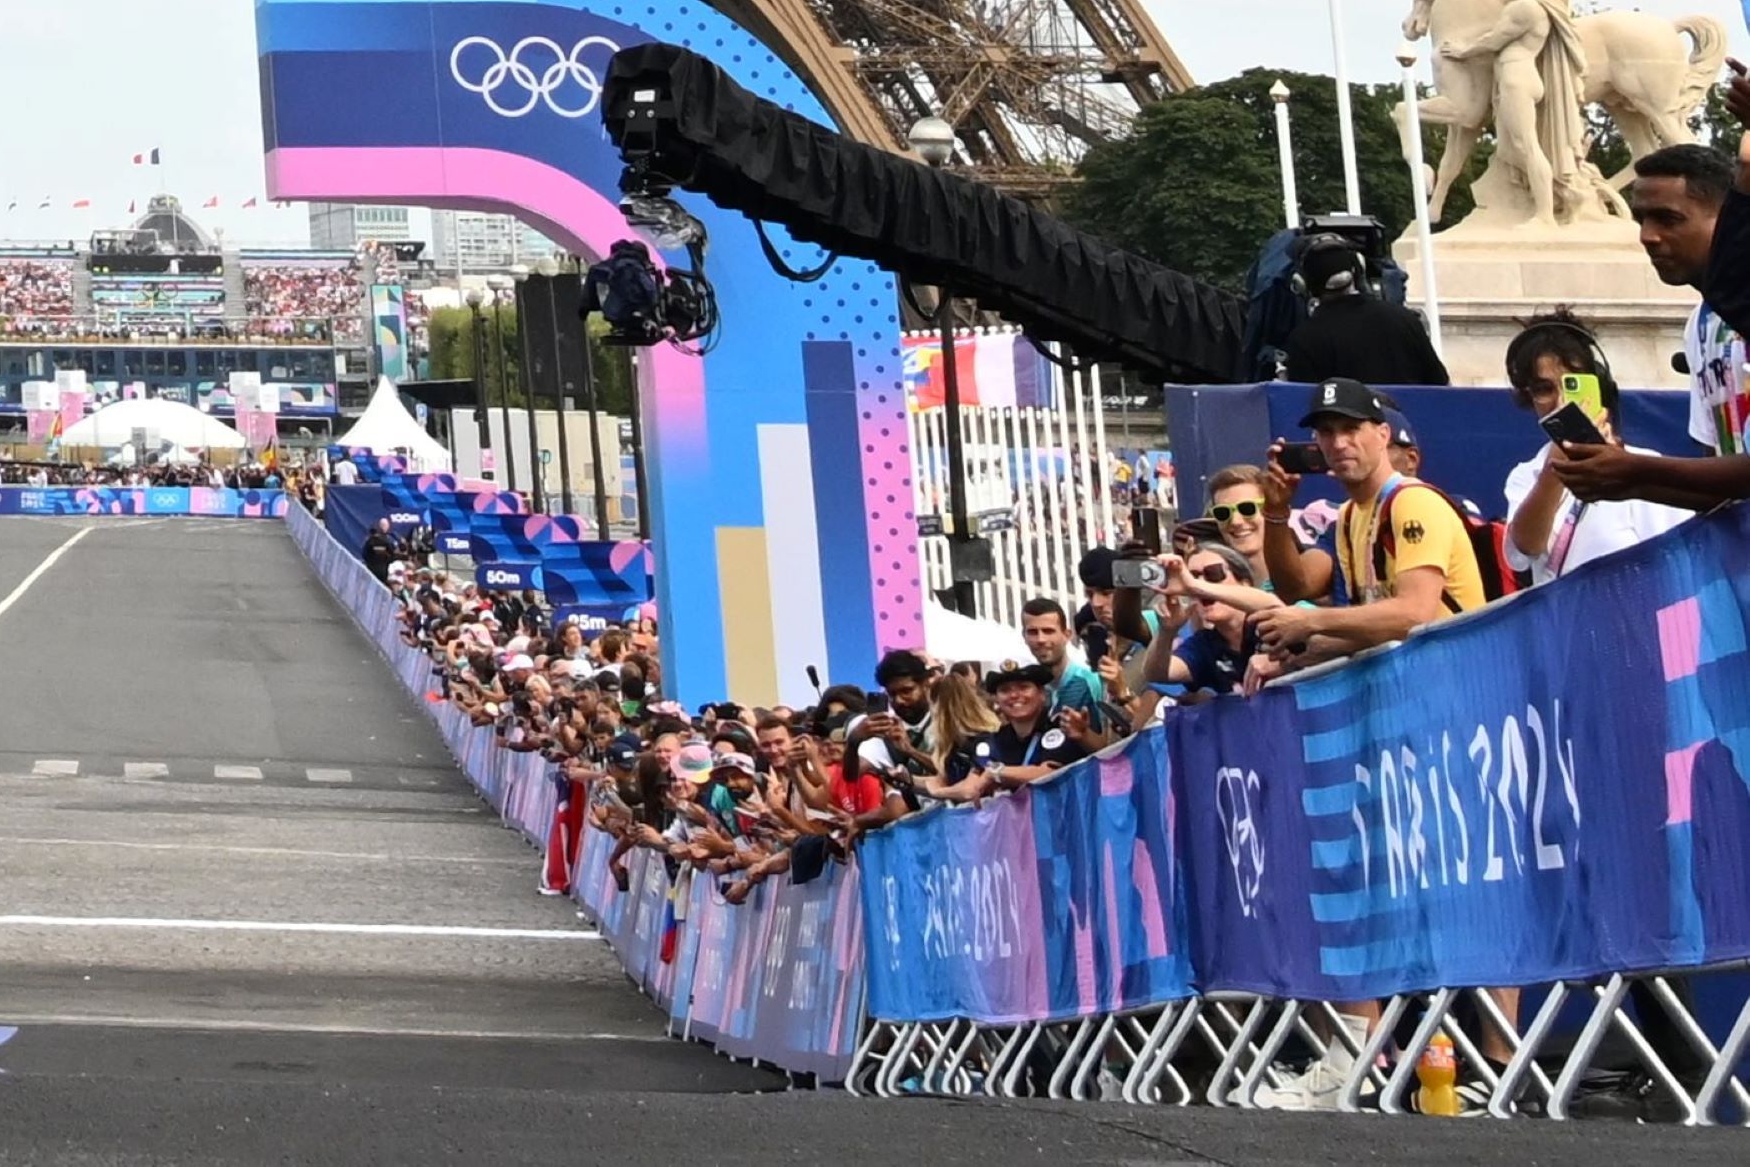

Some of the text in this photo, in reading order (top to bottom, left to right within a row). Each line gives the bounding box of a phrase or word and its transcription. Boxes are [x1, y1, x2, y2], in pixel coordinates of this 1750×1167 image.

[390, 514, 420, 524] 100m
[445, 538, 470, 549] 75m
[486, 571, 521, 584] 50m
